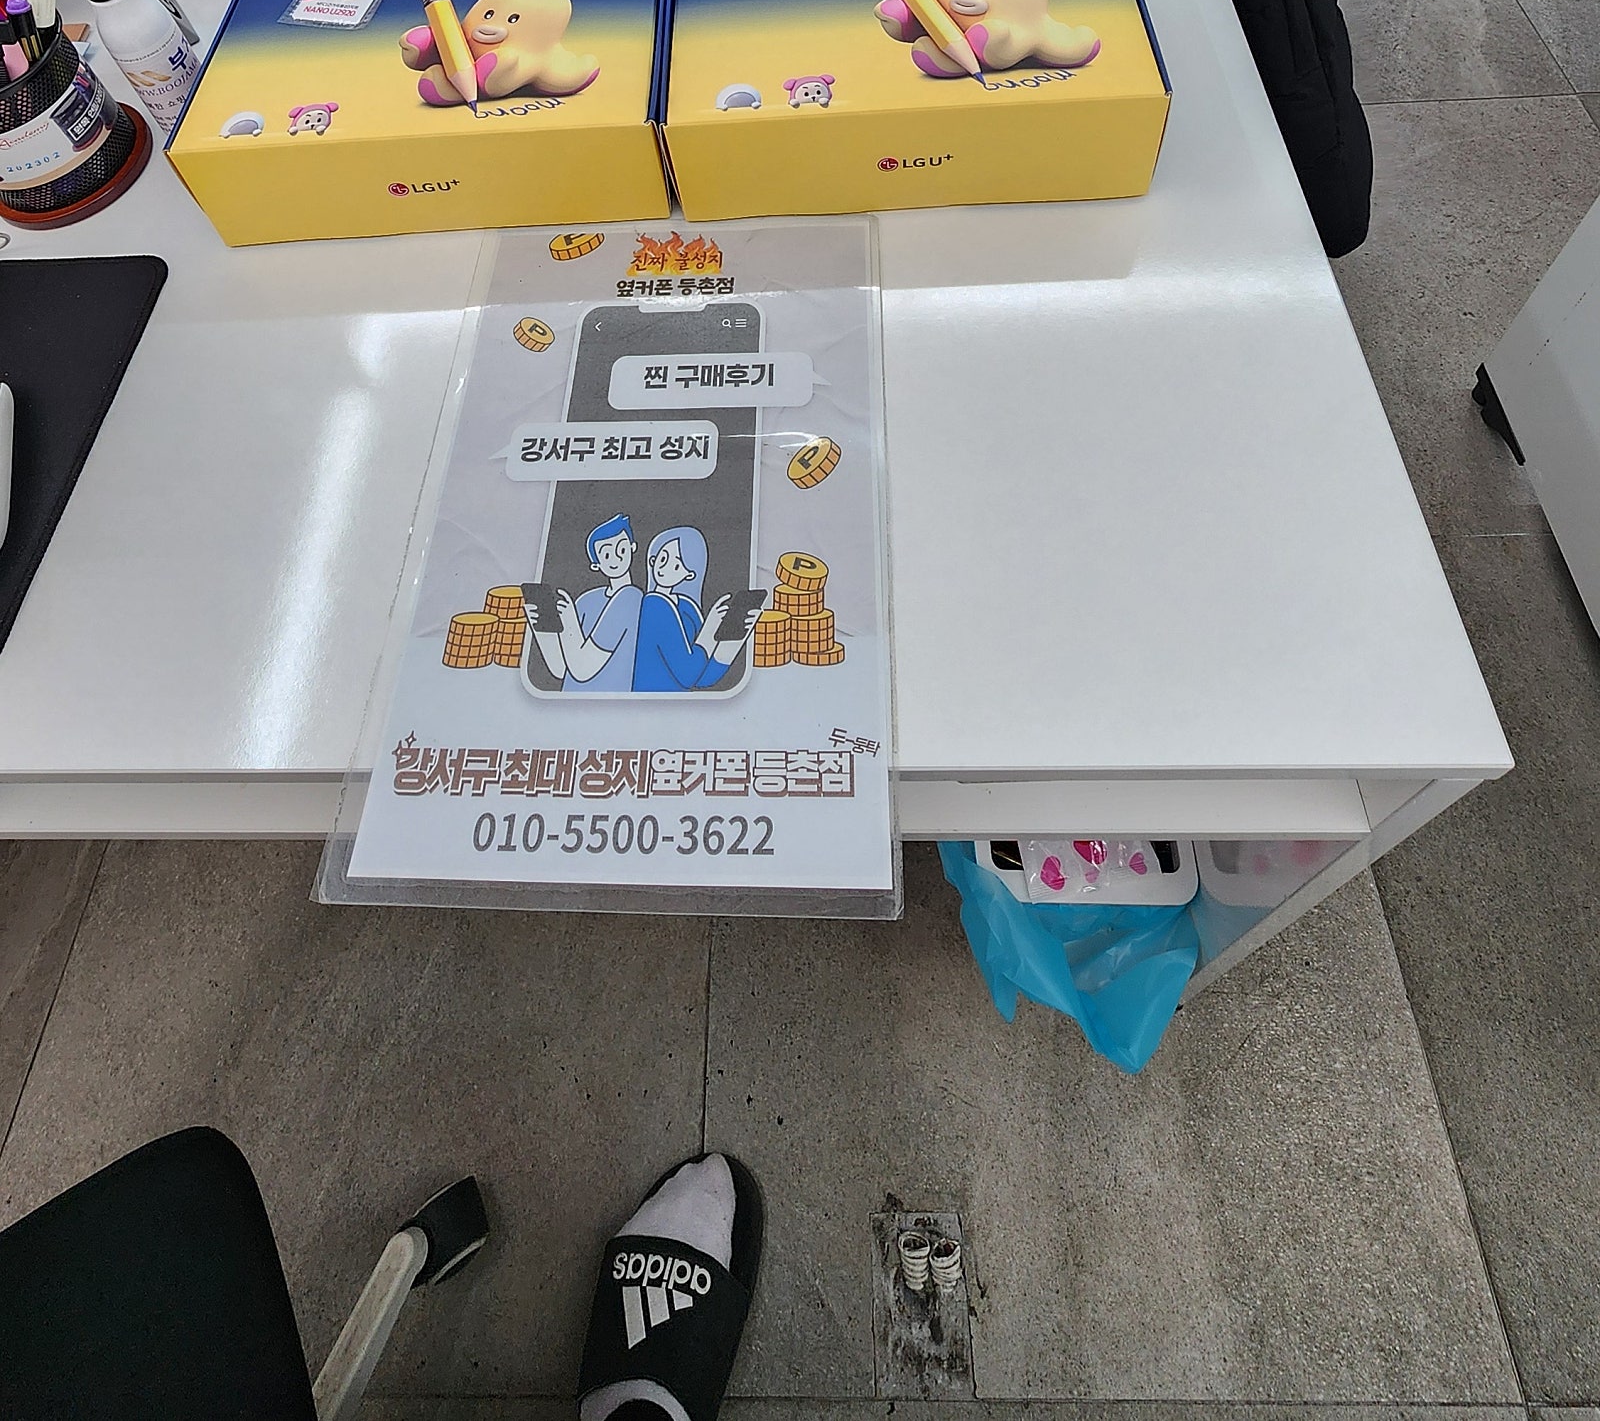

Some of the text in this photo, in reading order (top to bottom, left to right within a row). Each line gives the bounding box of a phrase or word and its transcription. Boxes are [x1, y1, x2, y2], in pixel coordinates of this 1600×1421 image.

[303, 5, 330, 14] NANO
[629, 249, 724, 273] 진짜 불성지
[615, 276, 736, 298] 옆커폰 등촌점
[643, 362, 775, 390] 찐 구매후기
[520, 434, 711, 463] 강서구 최고 성지
[394, 746, 856, 798] 강서구 최대 성지 옆커폰 등촌점
[472, 812, 775, 857] 010-5500-3622
[613, 1251, 712, 1296] adidas
